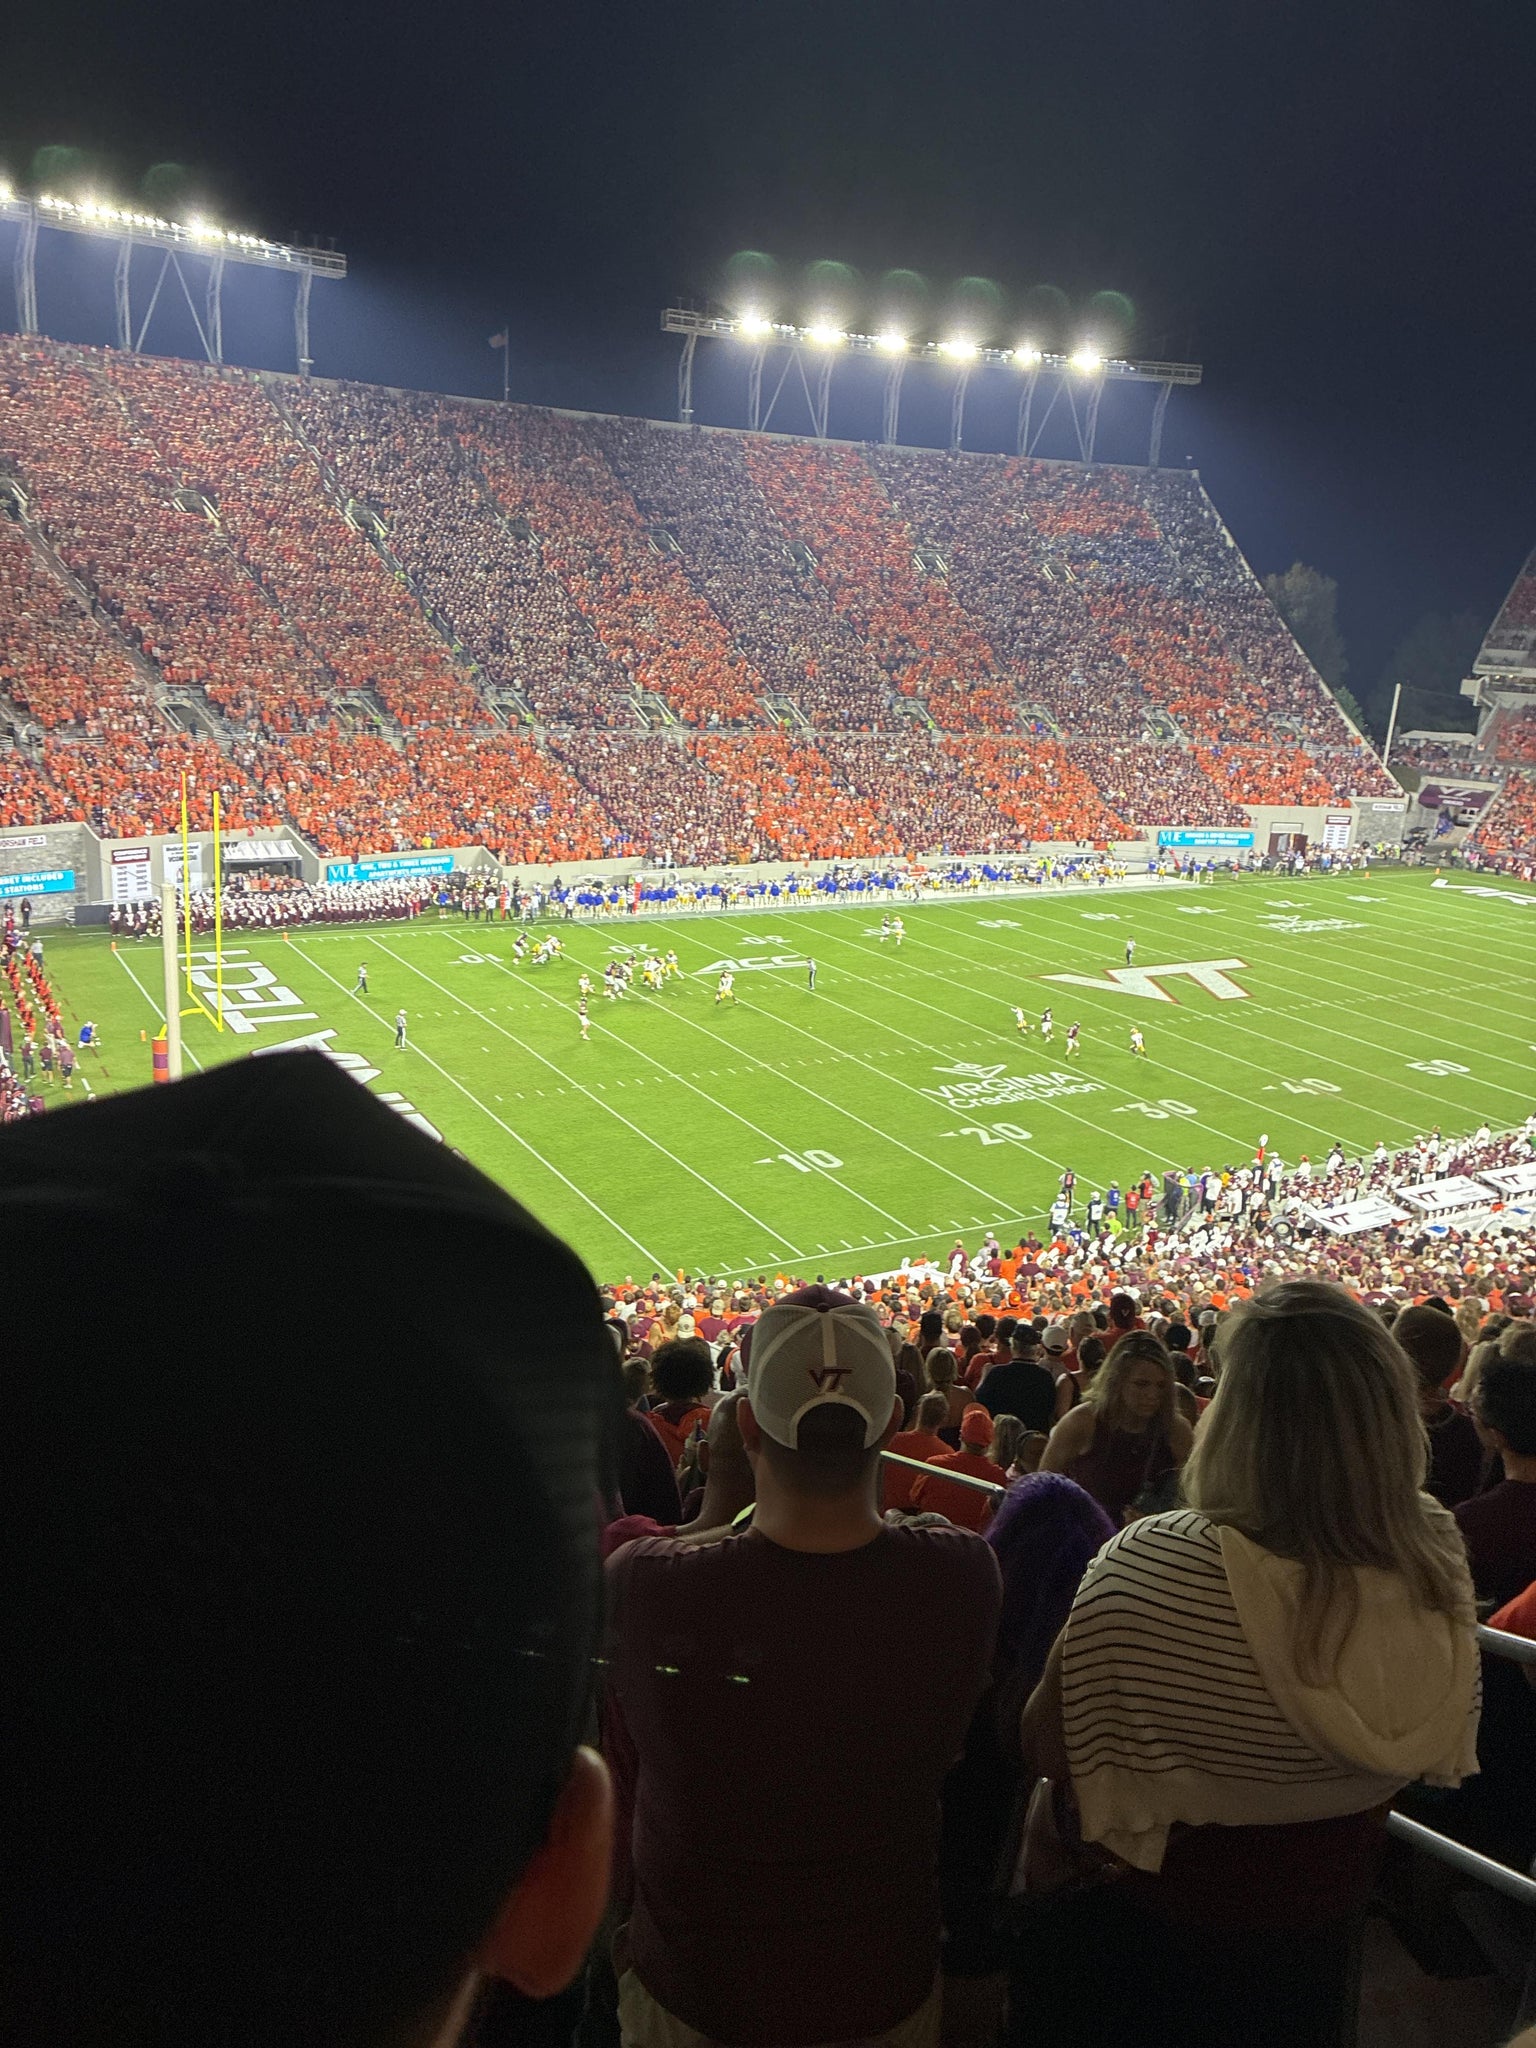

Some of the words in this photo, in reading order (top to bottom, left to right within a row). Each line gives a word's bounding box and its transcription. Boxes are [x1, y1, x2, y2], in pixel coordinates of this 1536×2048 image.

[1160, 831, 1182, 842] VUE
[329, 864, 358, 878] VUE
[459, 953, 504, 964] 10
[696, 954, 811, 974] ACC
[1025, 957, 1253, 1004] VT
[1406, 1059, 1471, 1077] 50
[920, 1071, 1085, 1099] VIRGINIA
[1280, 1077, 1343, 1096] 40
[949, 1088, 1037, 1109] Credit
[1029, 1081, 1107, 1098] Union
[1125, 1100, 1199, 1119] 30
[959, 1122, 1033, 1146] 20
[777, 1149, 844, 1173] 10
[1492, 1174, 1521, 1185] VT
[1409, 1190, 1439, 1203] VT
[1321, 1212, 1351, 1226] VT
[808, 1368, 853, 1392] VT
